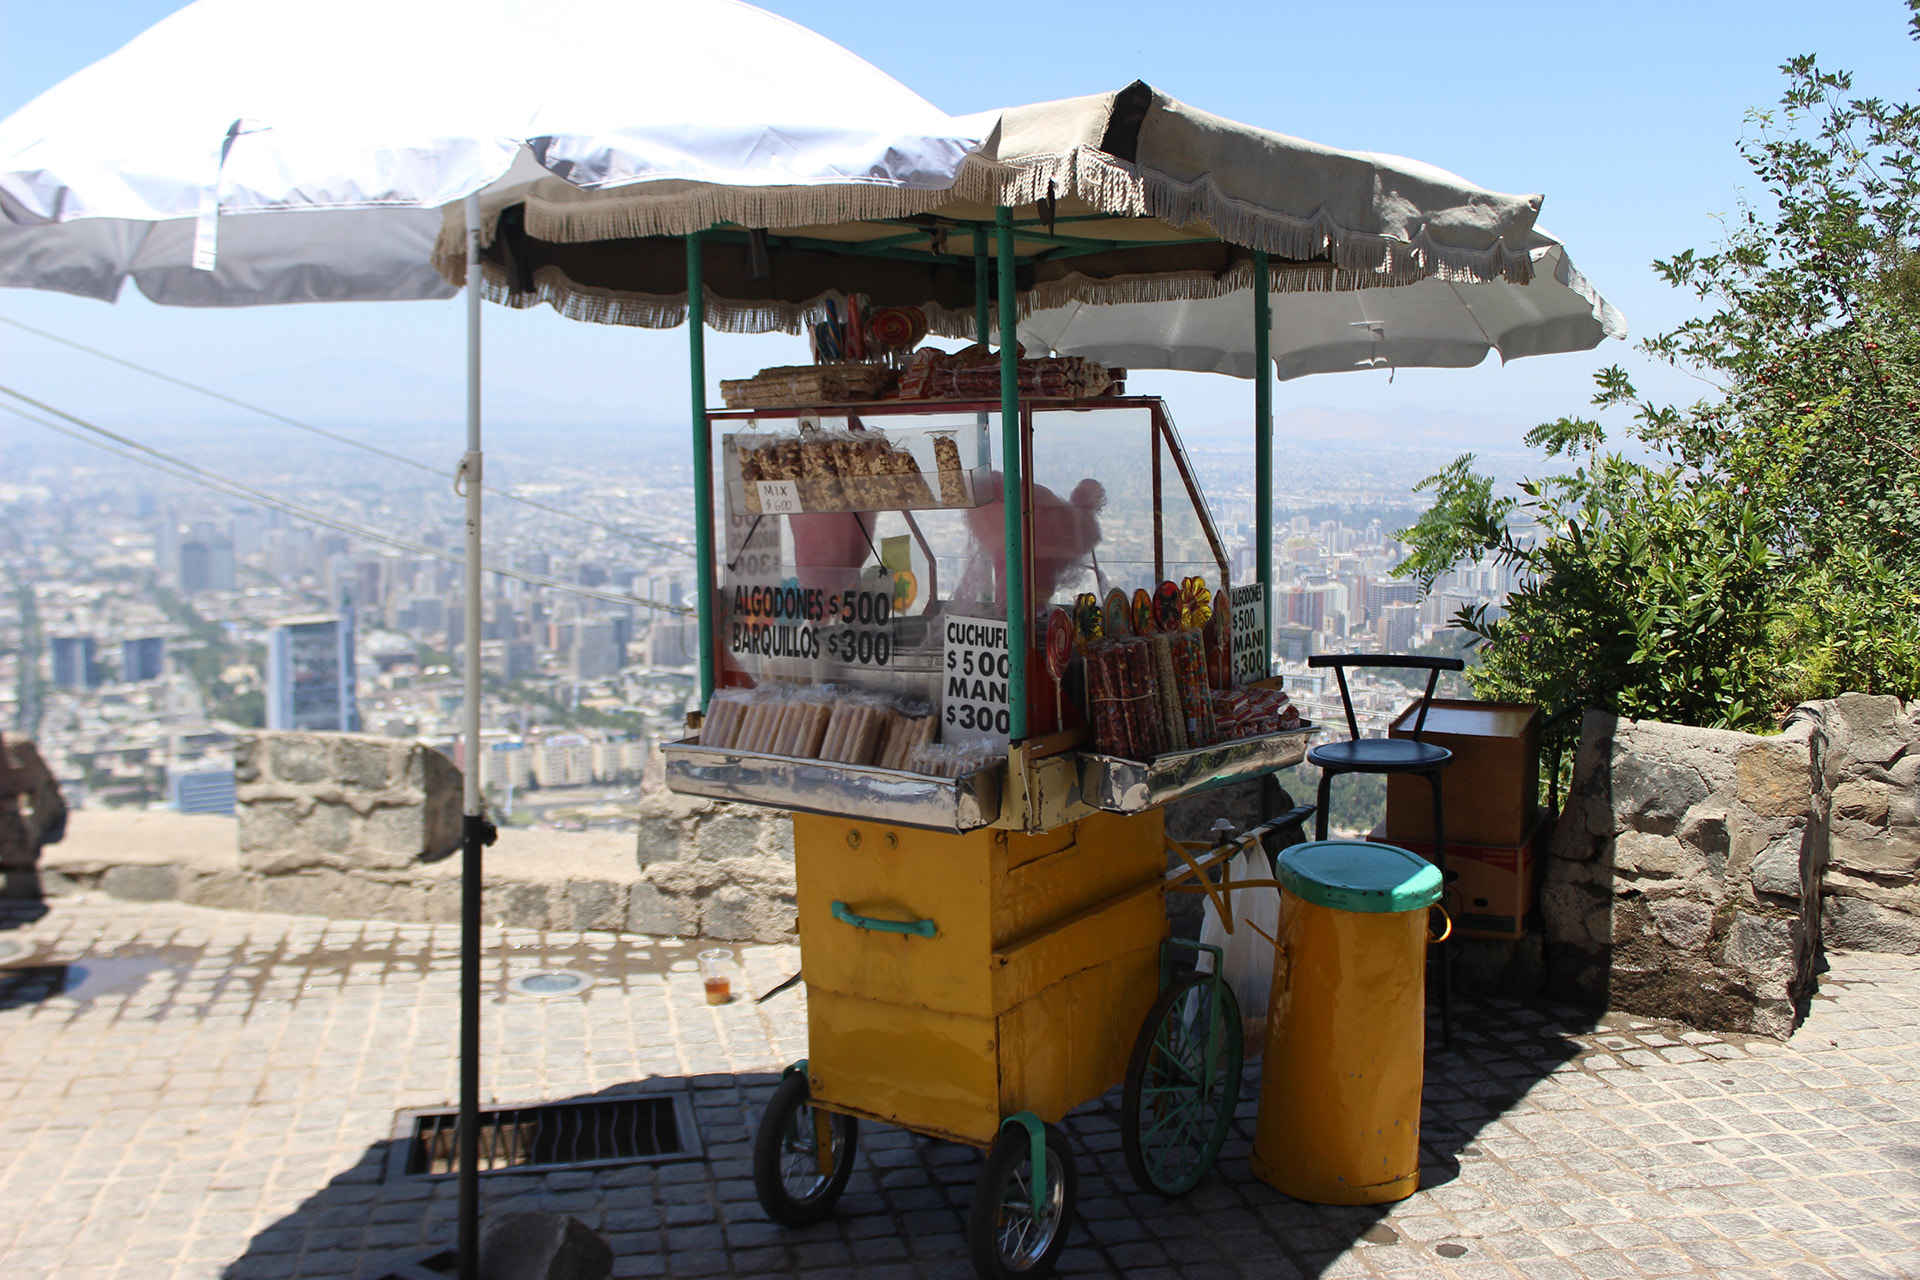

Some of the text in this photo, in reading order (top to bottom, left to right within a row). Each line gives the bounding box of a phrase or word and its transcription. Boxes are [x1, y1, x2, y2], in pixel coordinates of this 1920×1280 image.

[763, 484, 788, 497] MIX
[733, 585, 890, 626] ALGODONES $500
[1232, 584, 1262, 608] ALGODONES
[1232, 607, 1256, 632] $500
[732, 622, 890, 666] BARQUILLOS $300
[947, 622, 1009, 650] CUCHUFL
[1233, 629, 1264, 654] MANI
[1233, 649, 1264, 676] $300
